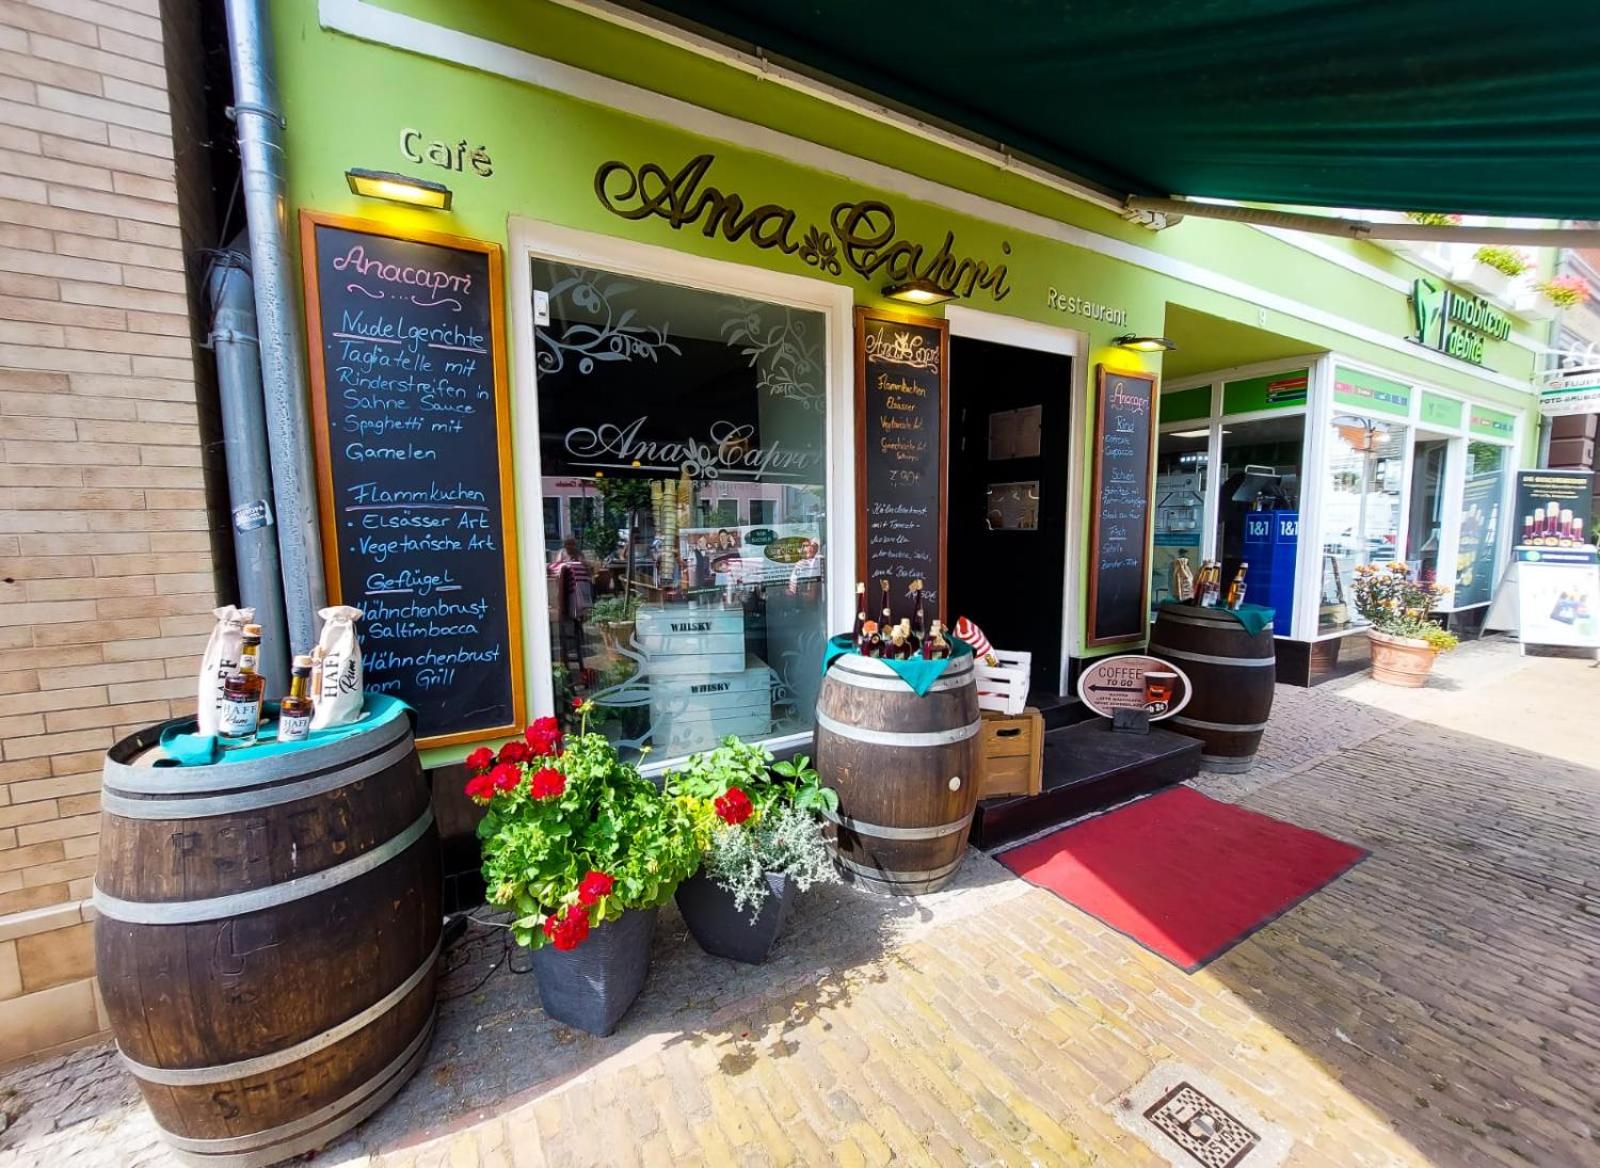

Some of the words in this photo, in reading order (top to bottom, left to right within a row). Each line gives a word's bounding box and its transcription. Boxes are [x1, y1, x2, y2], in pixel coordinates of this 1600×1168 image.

[400, 127, 493, 177] Café
[594, 154, 800, 254] Ana
[830, 200, 1011, 301] Capri
[333, 246, 472, 299] Anacapri
[1047, 287, 1127, 328] Restaurant
[1452, 293, 1512, 341] mobilcom
[341, 310, 485, 352] Nudelgerichte
[1448, 325, 1485, 364] debitel
[445, 360, 477, 377] mit
[336, 366, 467, 399] Rinderstreifen
[477, 384, 490, 400] in
[344, 389, 410, 410] Sahne
[420, 397, 477, 414] Sauce
[344, 414, 425, 436] Spaghetti
[431, 419, 464, 433] mit
[565, 416, 686, 461] Ana
[710, 420, 812, 481] Capri
[348, 481, 486, 503] Flammkuchen
[457, 511, 491, 529] Art
[1249, 521, 1269, 536] 1&1
[1280, 521, 1298, 536] 1&1
[359, 533, 462, 562] Vegetarische
[467, 534, 497, 551] Art
[366, 569, 454, 595] Geflügel
[670, 622, 713, 633] WHISKY
[362, 644, 500, 673] Hähnchenbrust
[415, 669, 456, 692] Grill
[1098, 666, 1143, 680] COFFEE
[690, 682, 731, 694] WHISKY
[1208, 1130, 1235, 1154] GAS
